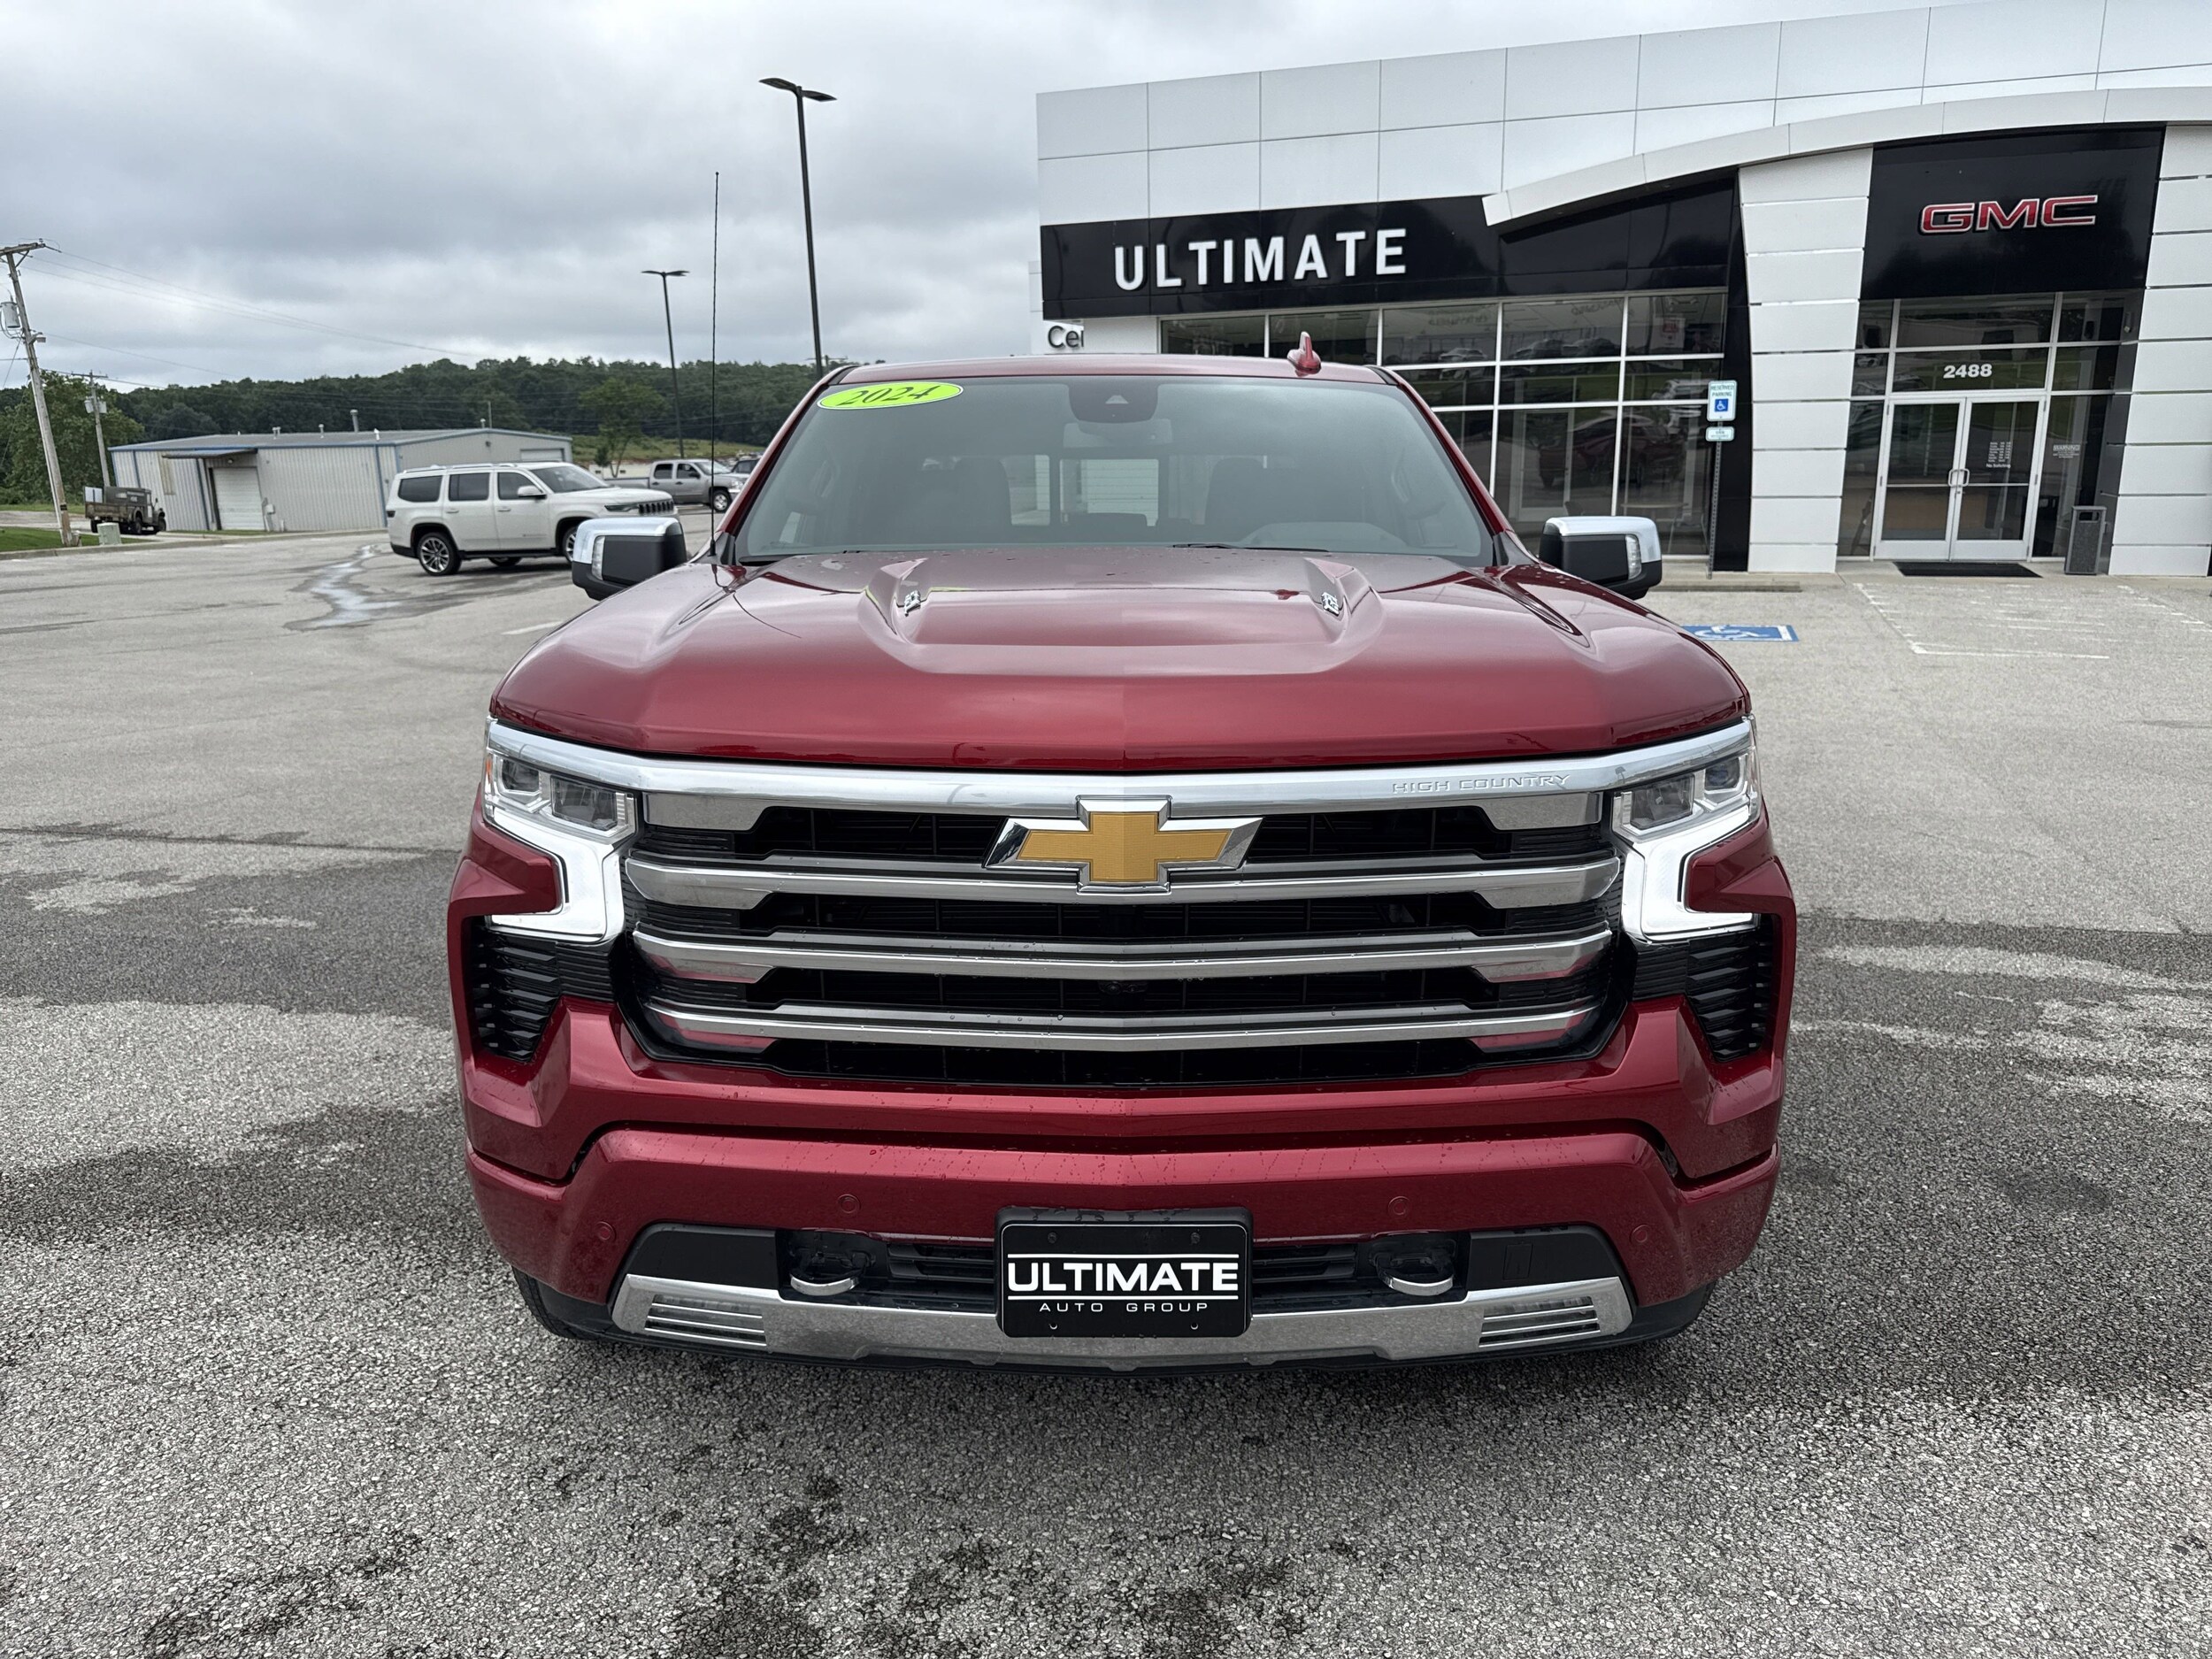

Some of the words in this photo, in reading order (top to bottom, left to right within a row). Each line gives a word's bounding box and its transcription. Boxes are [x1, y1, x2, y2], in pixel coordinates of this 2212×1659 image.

[1920, 194, 2098, 234] GMC
[1114, 227, 1407, 291] ULTIMATE
[1943, 363, 1993, 379] 2488
[835, 385, 941, 406] 2024
[1392, 780, 1450, 794] HIGH
[1460, 775, 1570, 790] COUNTRY
[1008, 1263, 1239, 1291] ULTIMATE
[1039, 1302, 1103, 1312] AUTO
[1125, 1302, 1208, 1312] GROUP
